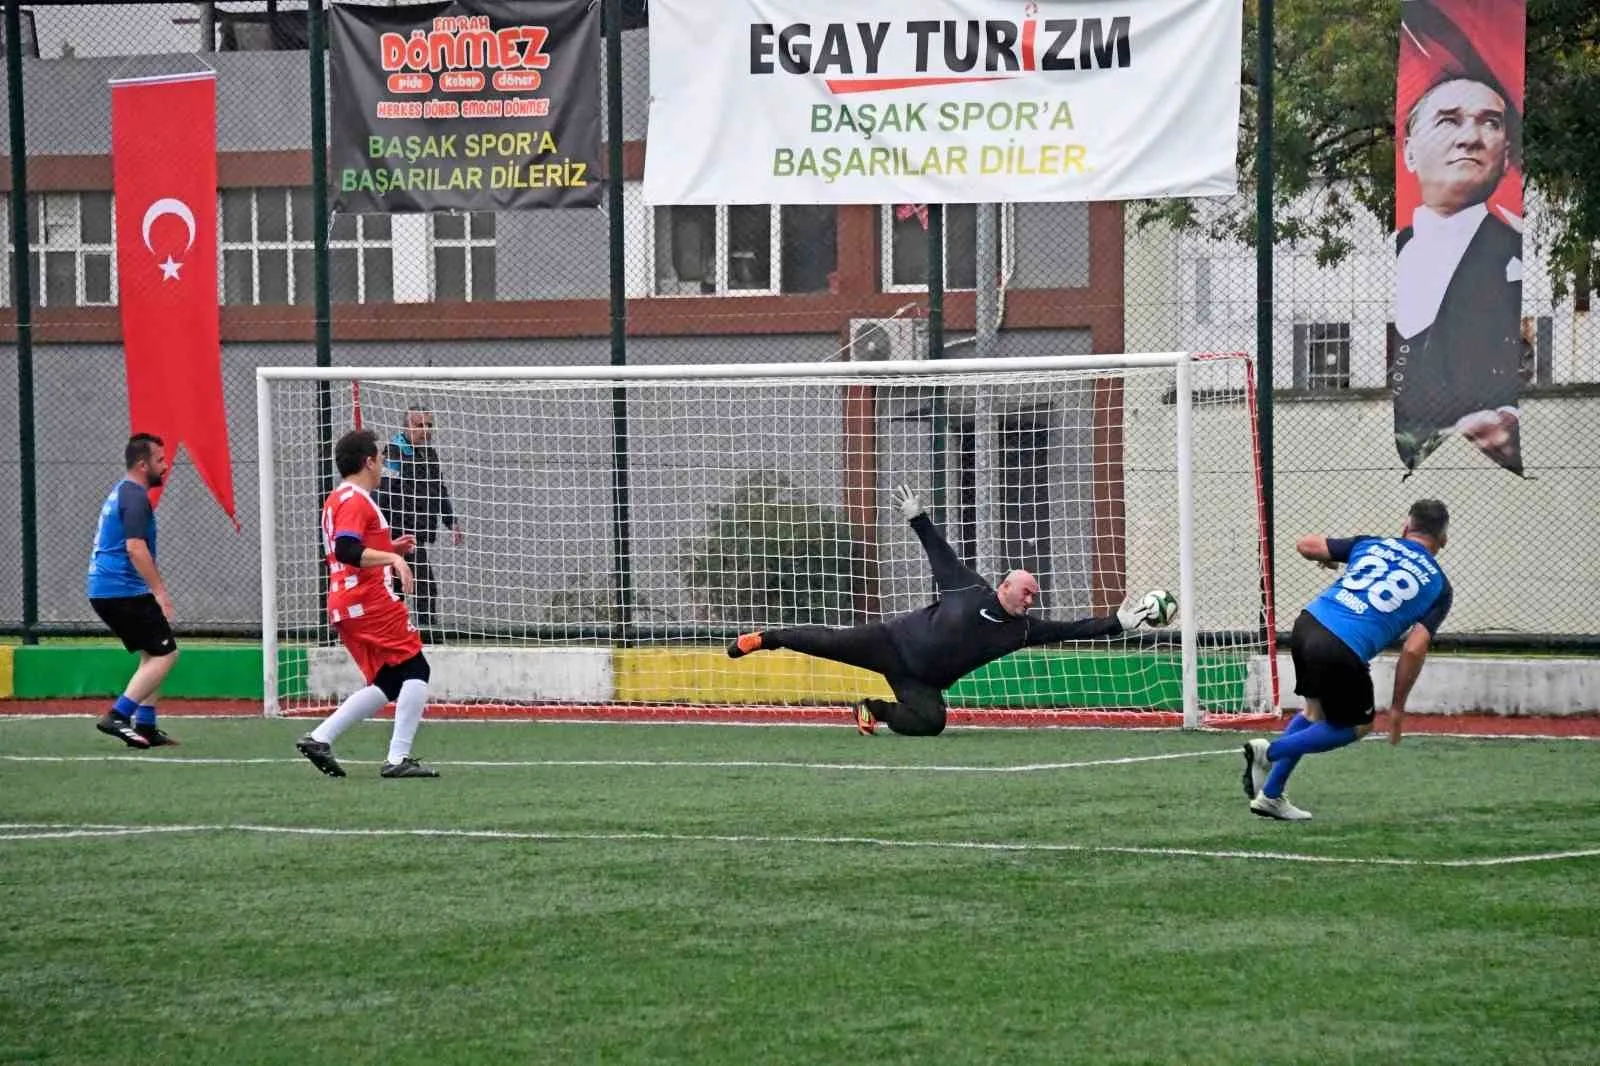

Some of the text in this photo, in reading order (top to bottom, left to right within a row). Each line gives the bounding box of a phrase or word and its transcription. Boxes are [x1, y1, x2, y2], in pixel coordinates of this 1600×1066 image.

[433, 16, 489, 32] EMRAH
[750, 2, 1131, 75] EGAY TURİZM
[398, 77, 423, 89] pide
[498, 74, 534, 86] döner
[377, 97, 549, 118] HERKES DÖNER EMRAH DÖNMEZ
[810, 101, 1075, 140] BAŞAK SPOR'A
[369, 131, 557, 163] BAŞAK SPOR'A
[773, 144, 968, 183] BAŞARILAR
[341, 158, 587, 196] BAŞARILAR DİLERİZ
[1342, 555, 1420, 613] 08
